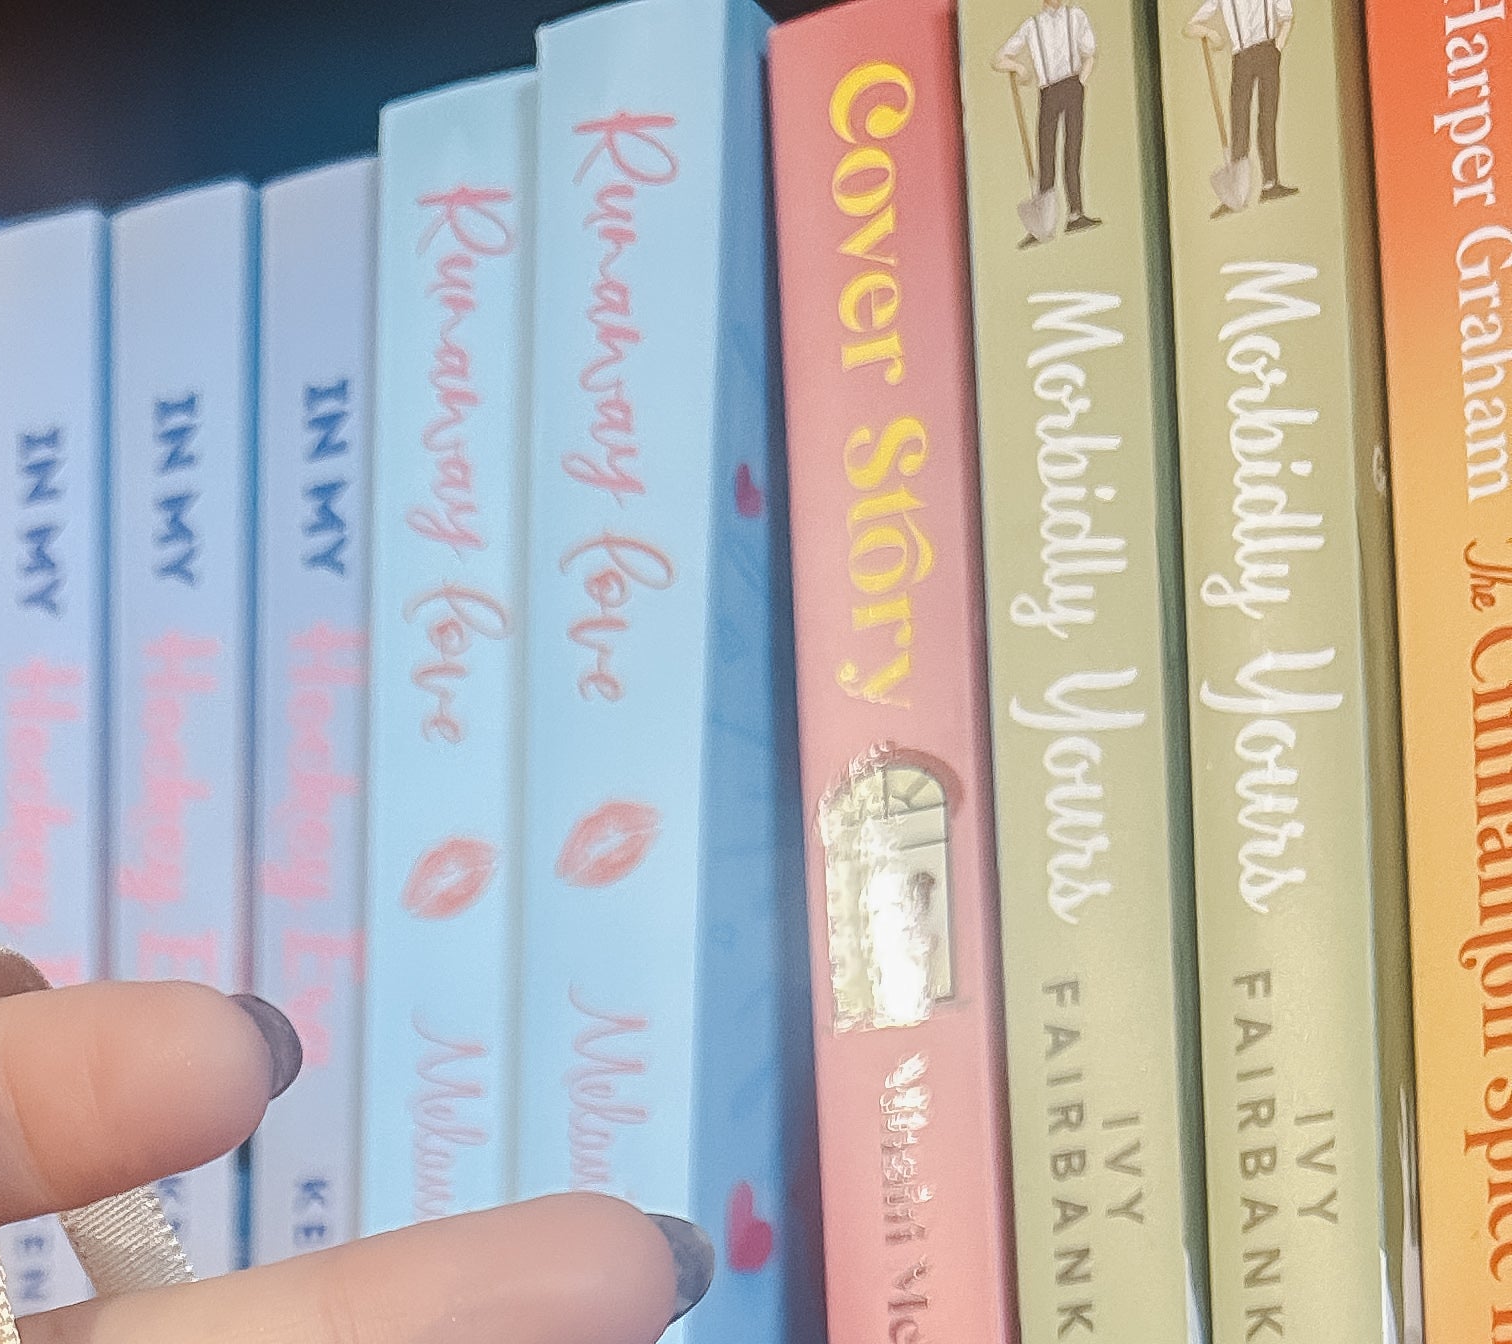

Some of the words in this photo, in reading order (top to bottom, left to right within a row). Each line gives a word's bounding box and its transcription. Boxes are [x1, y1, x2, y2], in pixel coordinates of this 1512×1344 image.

[1434, 0, 1505, 206] Harper
[562, 109, 679, 508] Runaway
[828, 58, 917, 387] Cover
[152, 391, 201, 473] IN
[304, 378, 352, 461] IN
[408, 184, 514, 573] Runaway
[1201, 260, 1327, 620] Morbidly
[1456, 222, 1512, 503] Graham
[18, 426, 65, 504] IN
[155, 490, 201, 587] MY
[302, 479, 350, 578] MY
[1011, 290, 1128, 640] Morbidly
[19, 522, 65, 618] MY
[562, 527, 676, 703] Love
[835, 415, 933, 710] Story
[1464, 538, 1512, 612] The
[405, 580, 510, 745] Love
[1010, 668, 1146, 923] Yours
[1201, 647, 1344, 914] Yours
[1101, 1111, 1146, 1226] IVY
[1293, 1109, 1339, 1226] IVY
